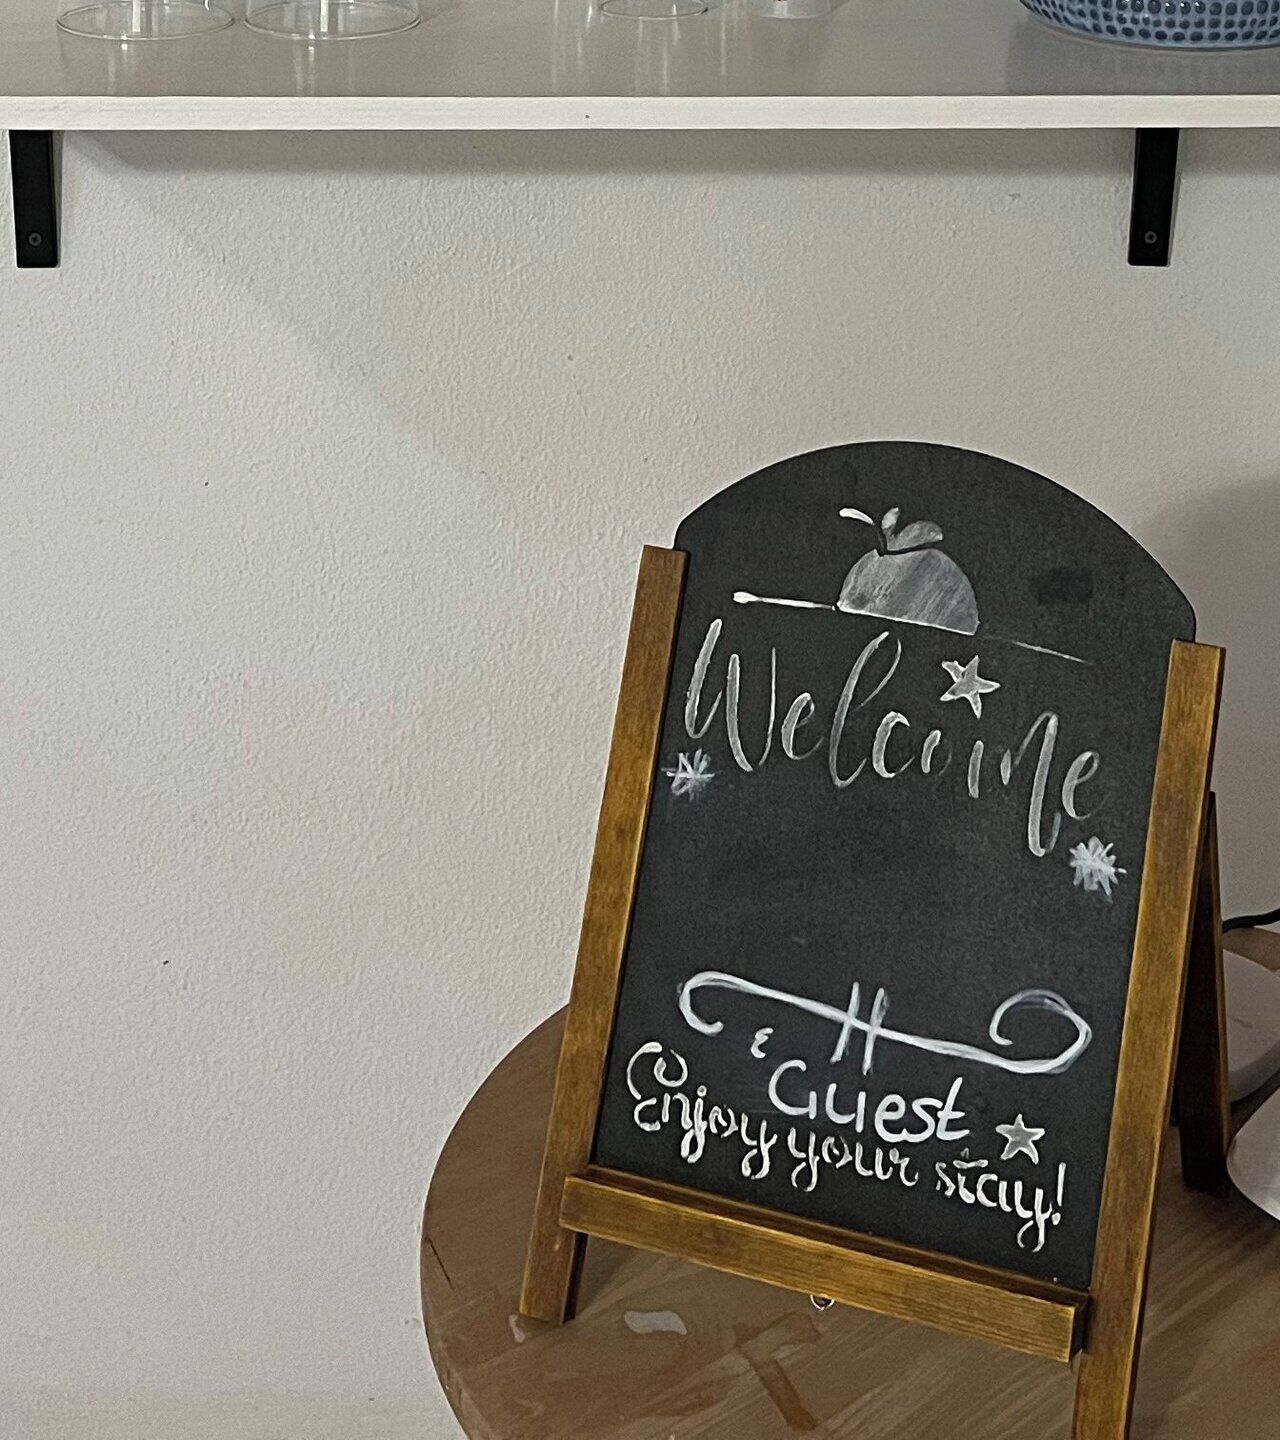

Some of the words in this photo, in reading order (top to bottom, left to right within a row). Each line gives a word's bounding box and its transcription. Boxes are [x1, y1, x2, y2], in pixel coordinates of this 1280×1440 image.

[684, 618, 1101, 858] Welcome
[626, 1041, 778, 1180] Enjoy
[787, 1127, 920, 1192] your
[935, 1148, 1067, 1253] stay!
[767, 1059, 972, 1143] Guest
